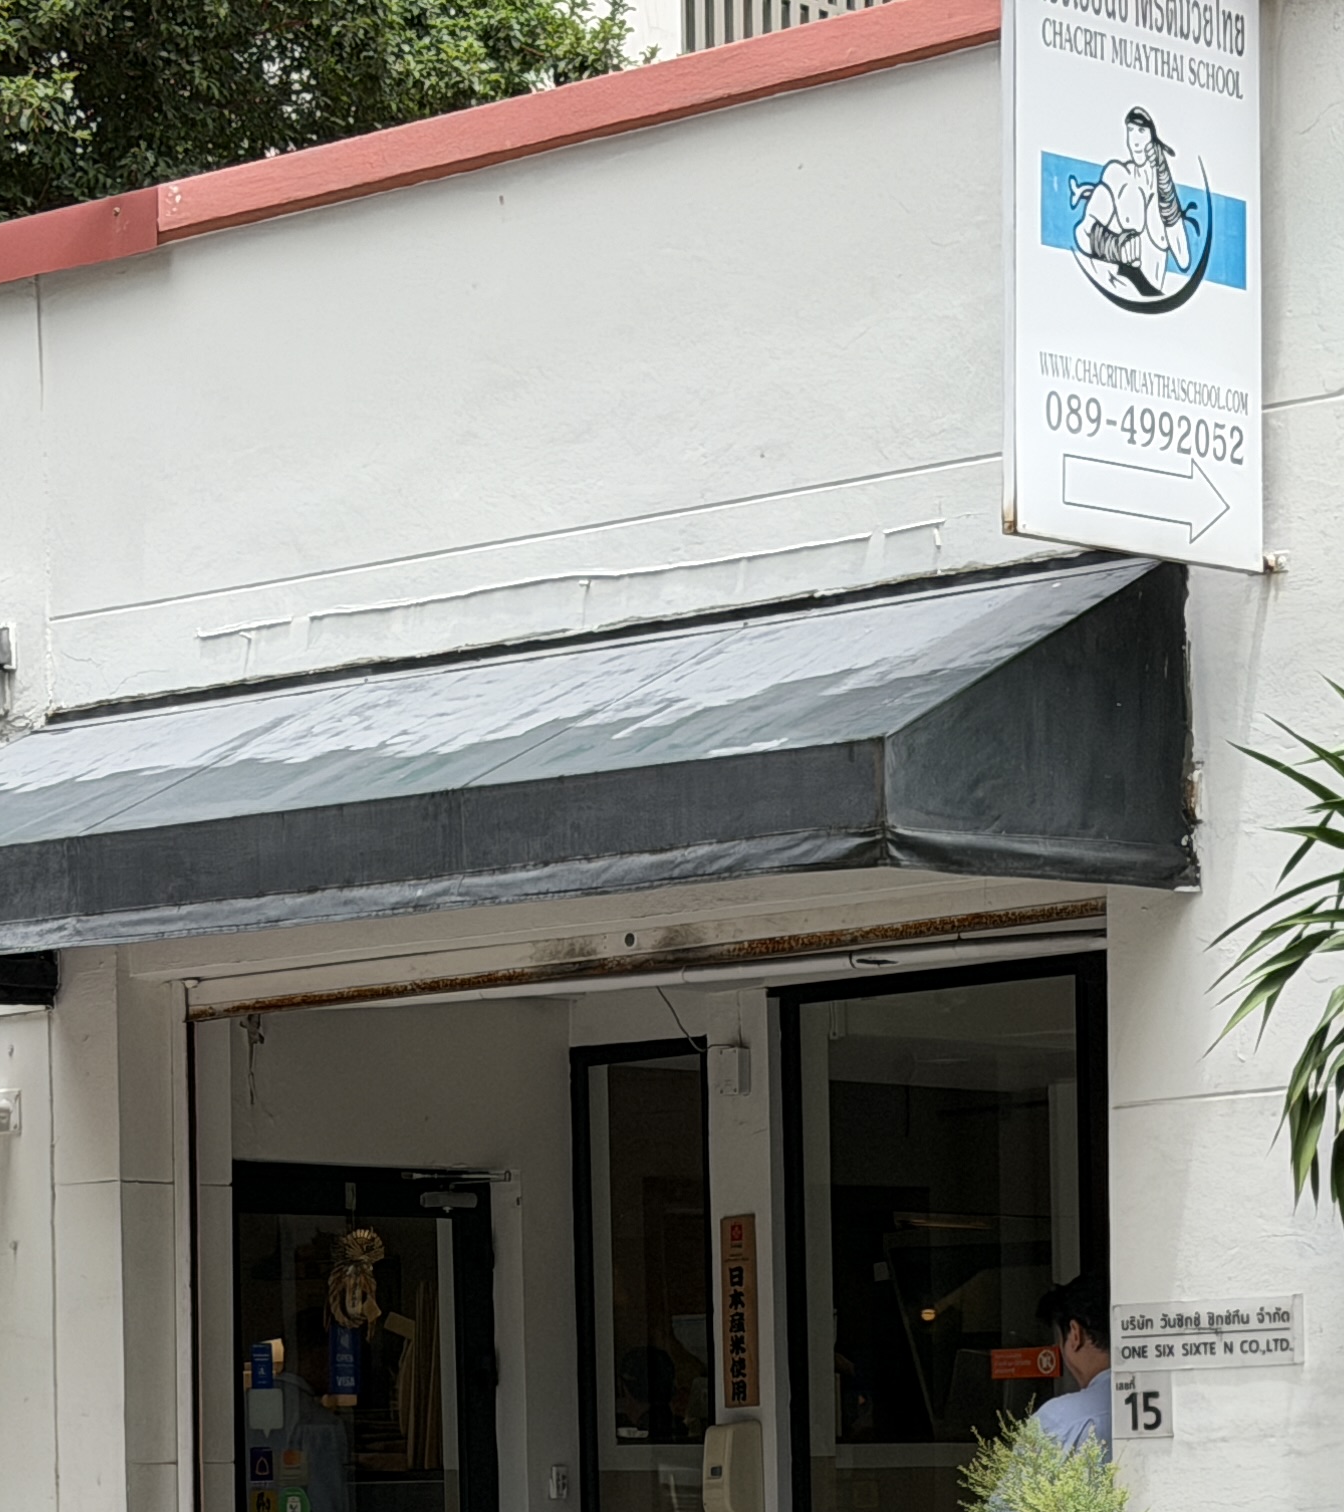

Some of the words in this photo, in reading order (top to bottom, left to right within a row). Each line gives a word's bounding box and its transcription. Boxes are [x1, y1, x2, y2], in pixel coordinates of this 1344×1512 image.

[1041, 17, 1107, 62] CHACRIT
[1111, 34, 1185, 83] MUAYTHAI
[1188, 58, 1244, 101] SCHOOL
[1039, 351, 1249, 416] WWW.CHACRITMUAYTHAISCHOOL.COM
[1045, 390, 1244, 465] 089-4992052
[1121, 1345, 1148, 1360] ONE
[1155, 1343, 1175, 1358] SIX
[1123, 1390, 1163, 1432] 15
